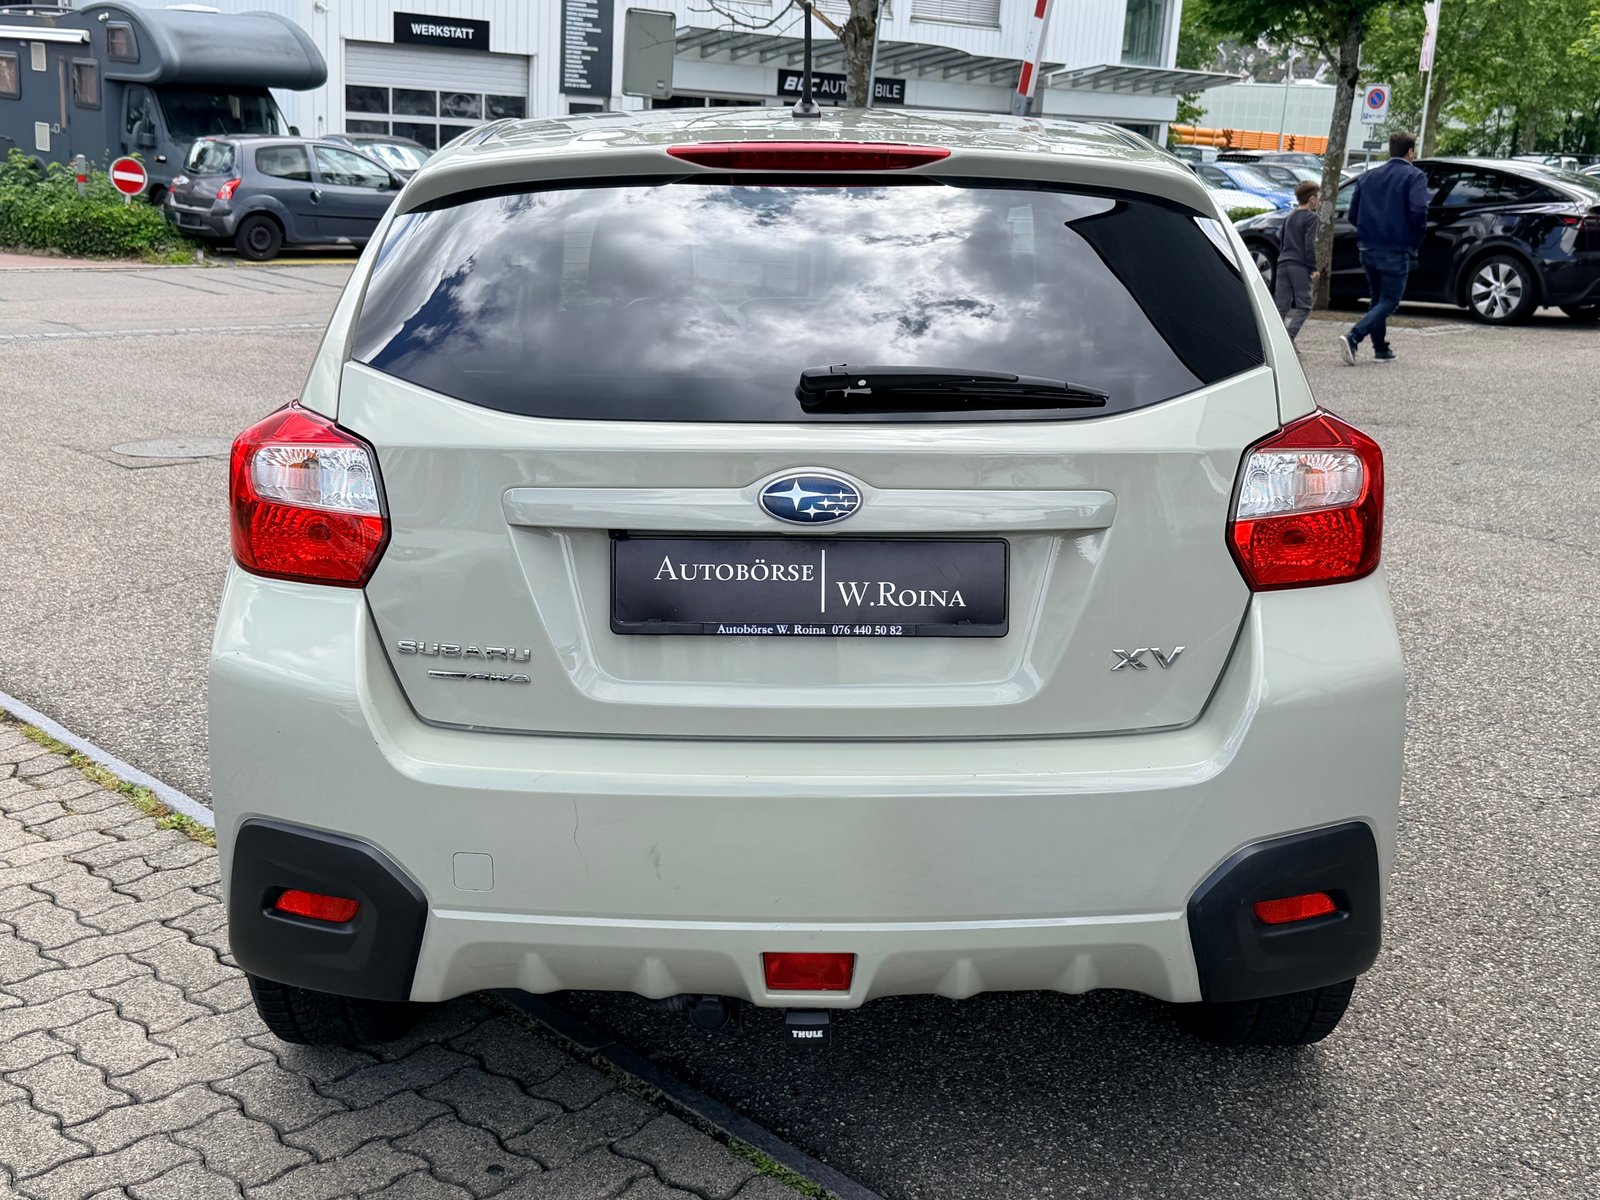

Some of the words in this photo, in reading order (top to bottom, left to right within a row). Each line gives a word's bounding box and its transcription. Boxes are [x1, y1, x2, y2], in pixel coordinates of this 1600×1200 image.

[410, 22, 475, 40] WERKSTATT
[821, 79, 901, 98] AUTBILE
[716, 624, 774, 635] Autobörse
[776, 624, 790, 635] W.
[793, 624, 827, 635] Roina
[831, 625, 851, 635] 076
[853, 625, 872, 635] 440
[874, 625, 887, 635] 50
[889, 625, 903, 636] 82
[397, 639, 532, 663] SUBARU
[1110, 645, 1186, 672] XV
[791, 1029, 824, 1038] THULE
